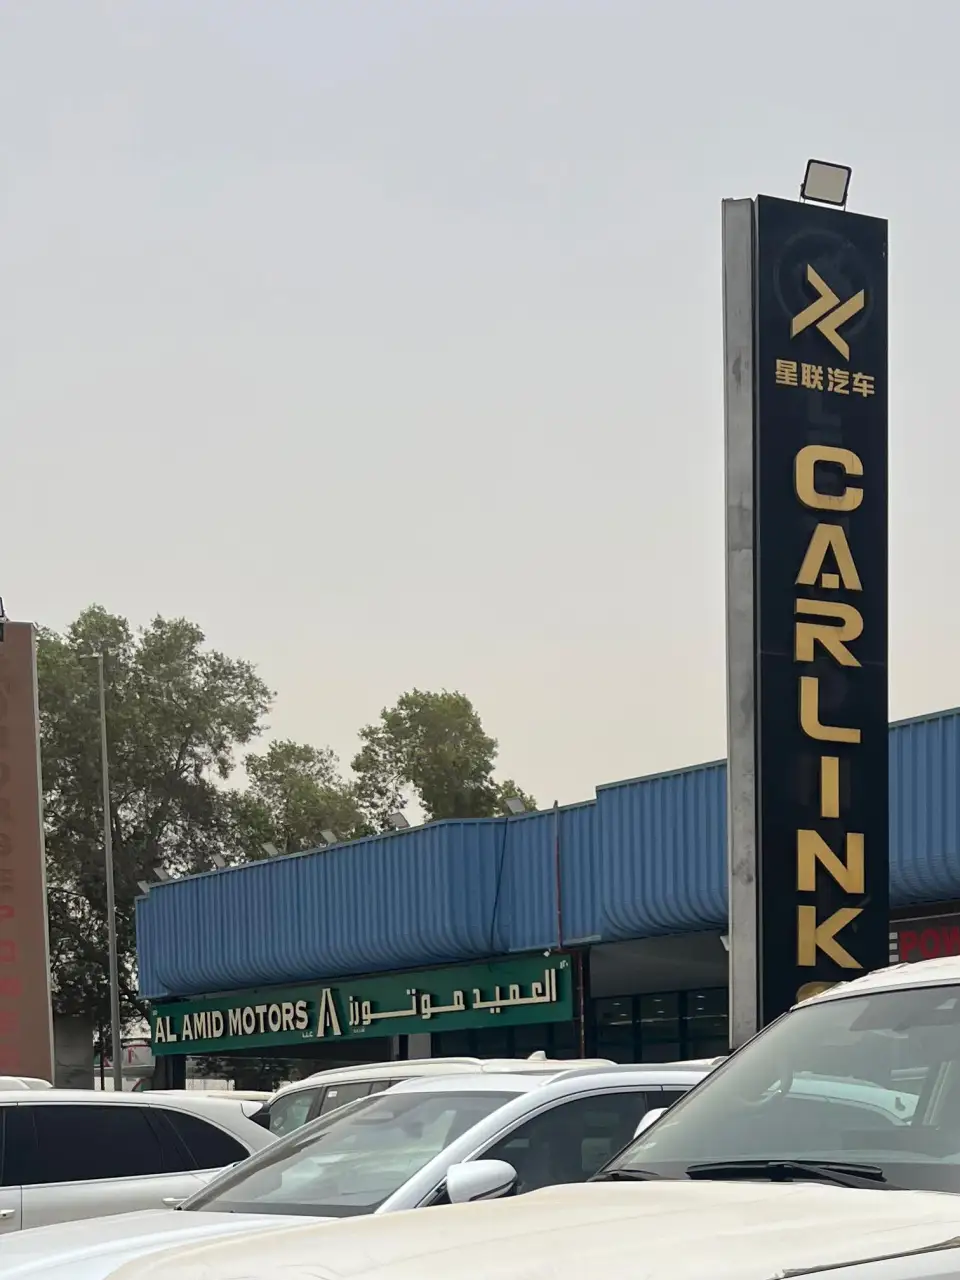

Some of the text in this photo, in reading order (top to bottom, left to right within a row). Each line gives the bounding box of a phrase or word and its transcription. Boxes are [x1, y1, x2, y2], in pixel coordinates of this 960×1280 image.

[775, 359, 875, 397] 星联汽车
[348, 968, 557, 1026] العميد موتورز
[154, 1000, 308, 1043] AL AMID MOTORS
